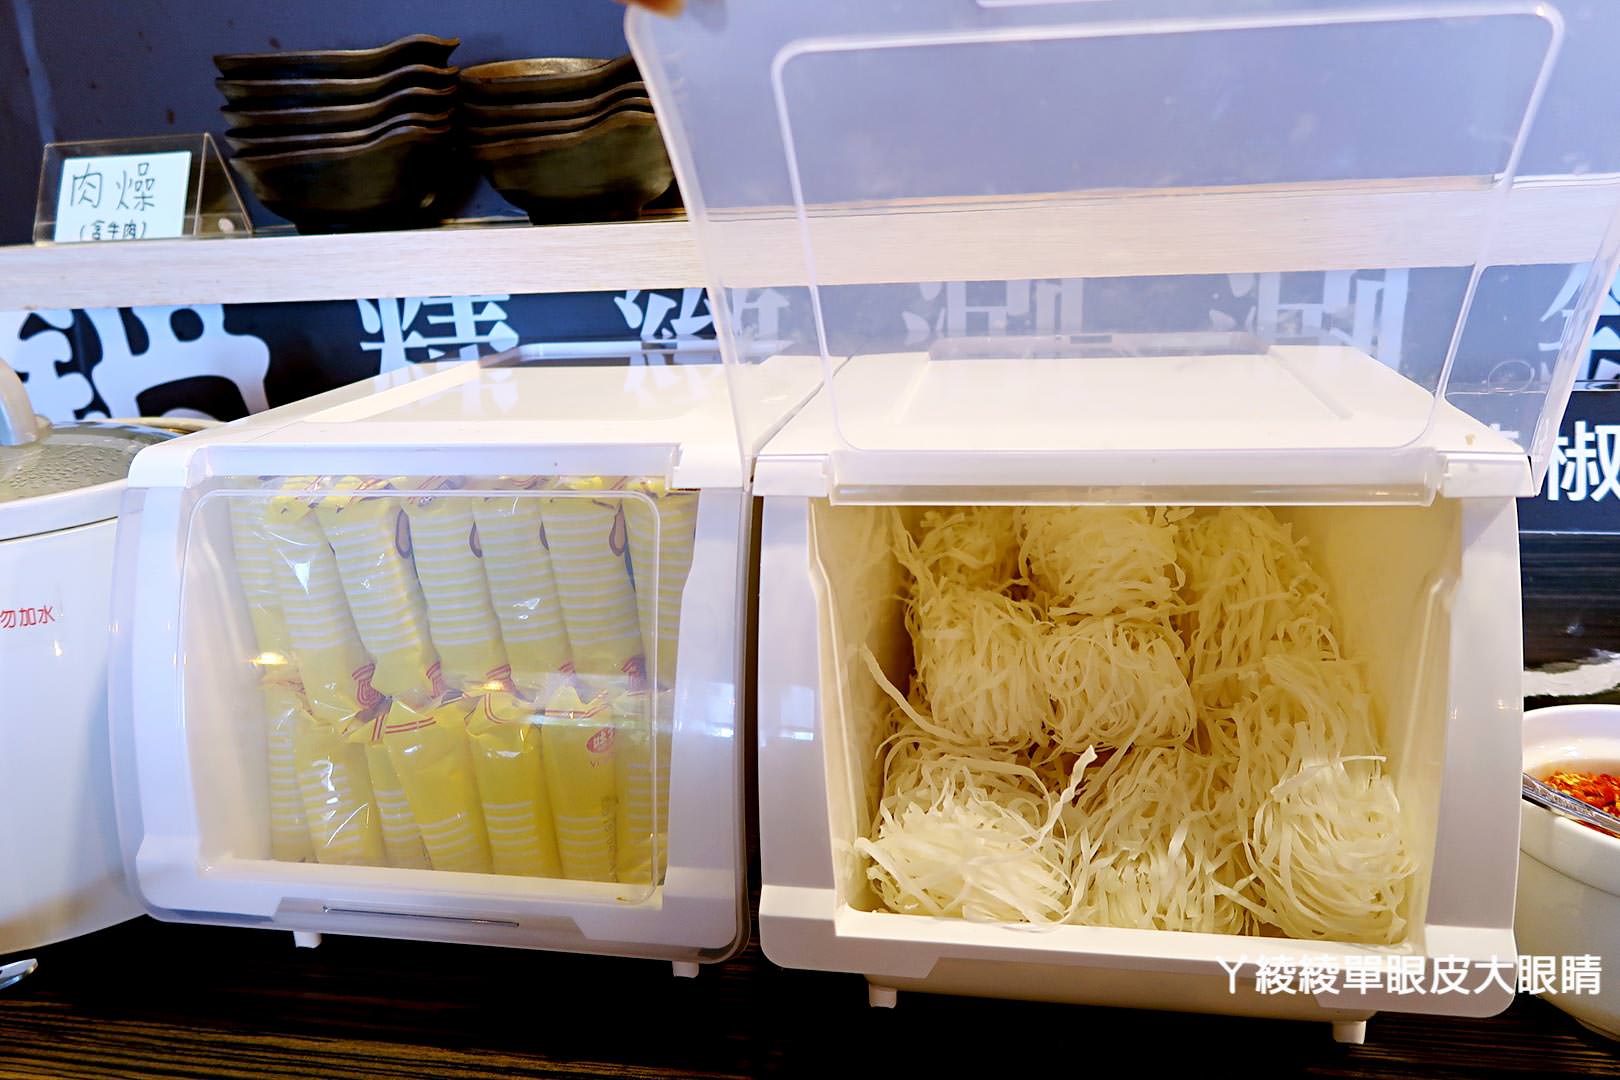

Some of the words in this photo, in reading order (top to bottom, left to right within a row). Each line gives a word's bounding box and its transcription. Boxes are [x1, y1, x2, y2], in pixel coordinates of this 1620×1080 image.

[70, 162, 156, 212] 肉燥
[0, 604, 56, 629] 勿加水
